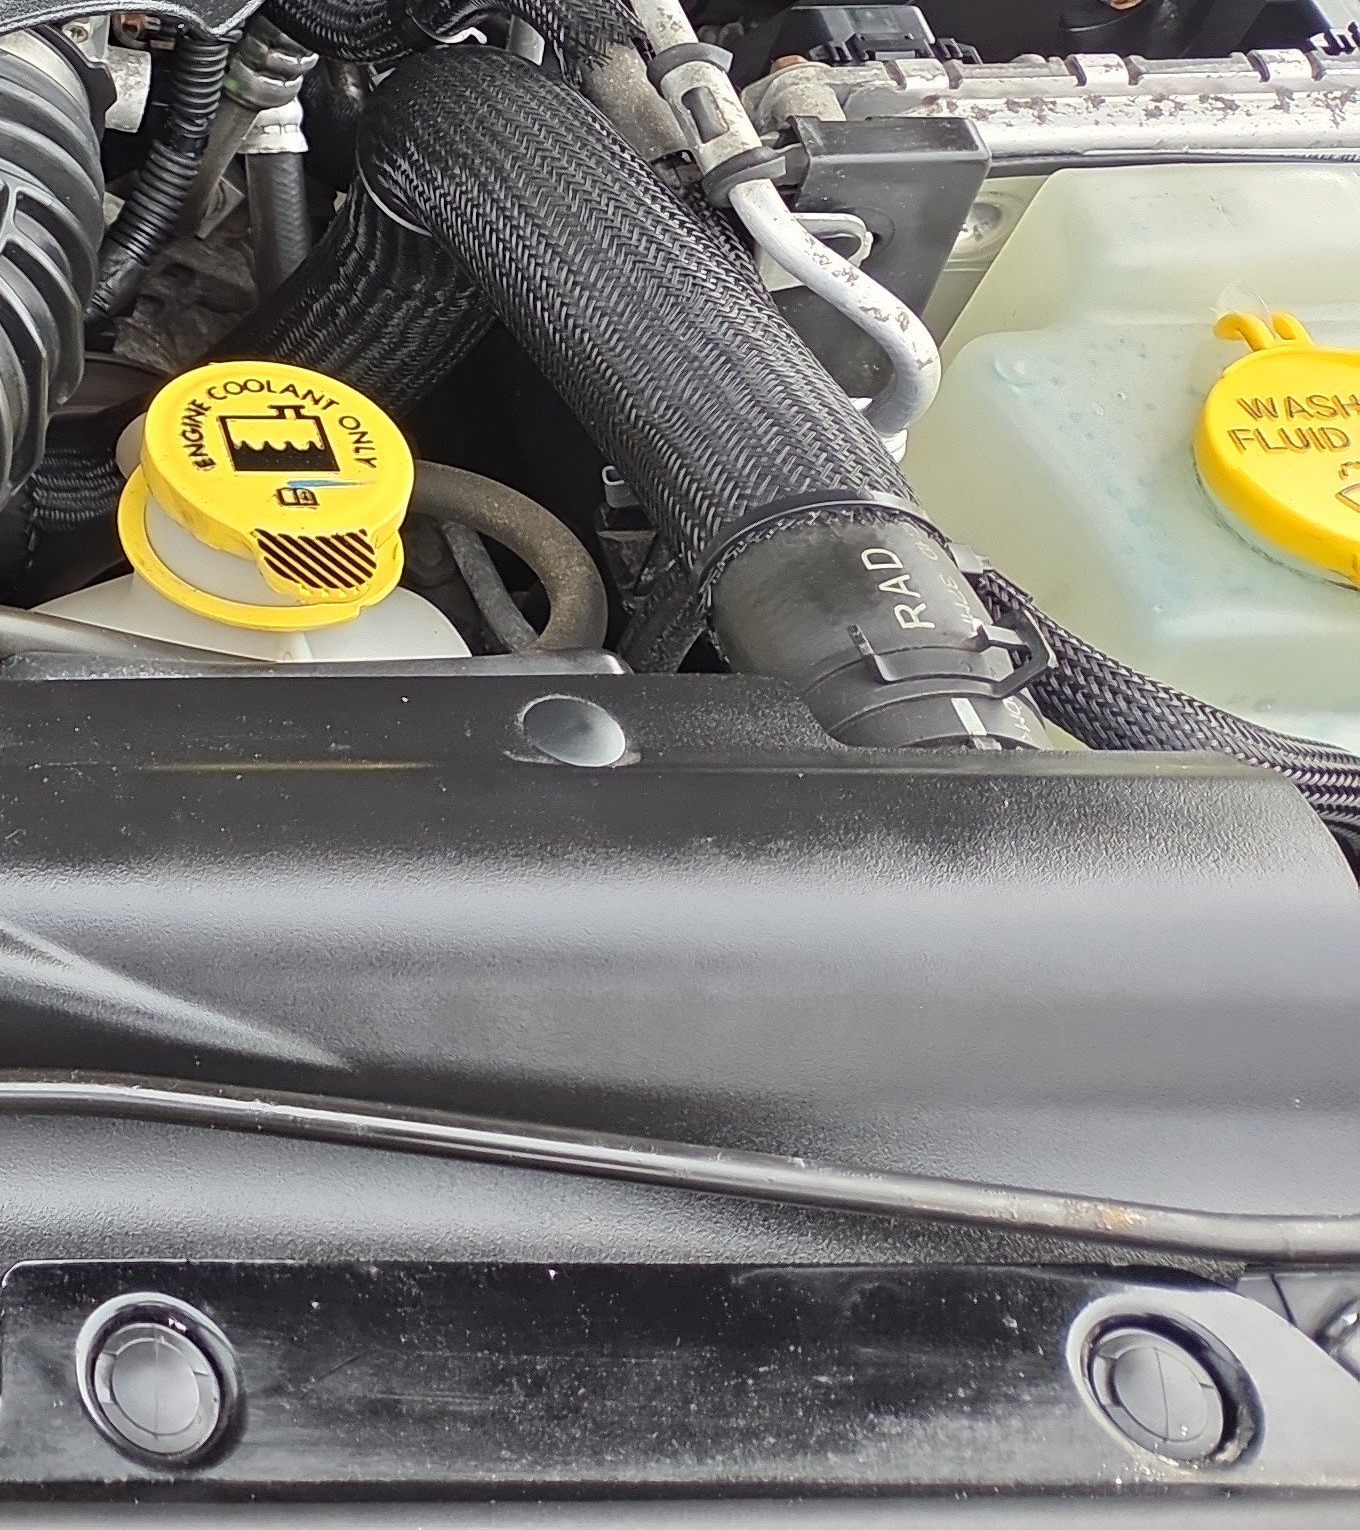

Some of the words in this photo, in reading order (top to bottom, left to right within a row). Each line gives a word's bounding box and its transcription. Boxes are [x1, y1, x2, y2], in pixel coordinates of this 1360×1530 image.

[180, 397, 214, 472] ENGINE
[206, 378, 340, 411] COOLANT
[338, 414, 378, 469] ONLY
[1226, 426, 1351, 455] FLUID
[861, 547, 935, 629] RAD
